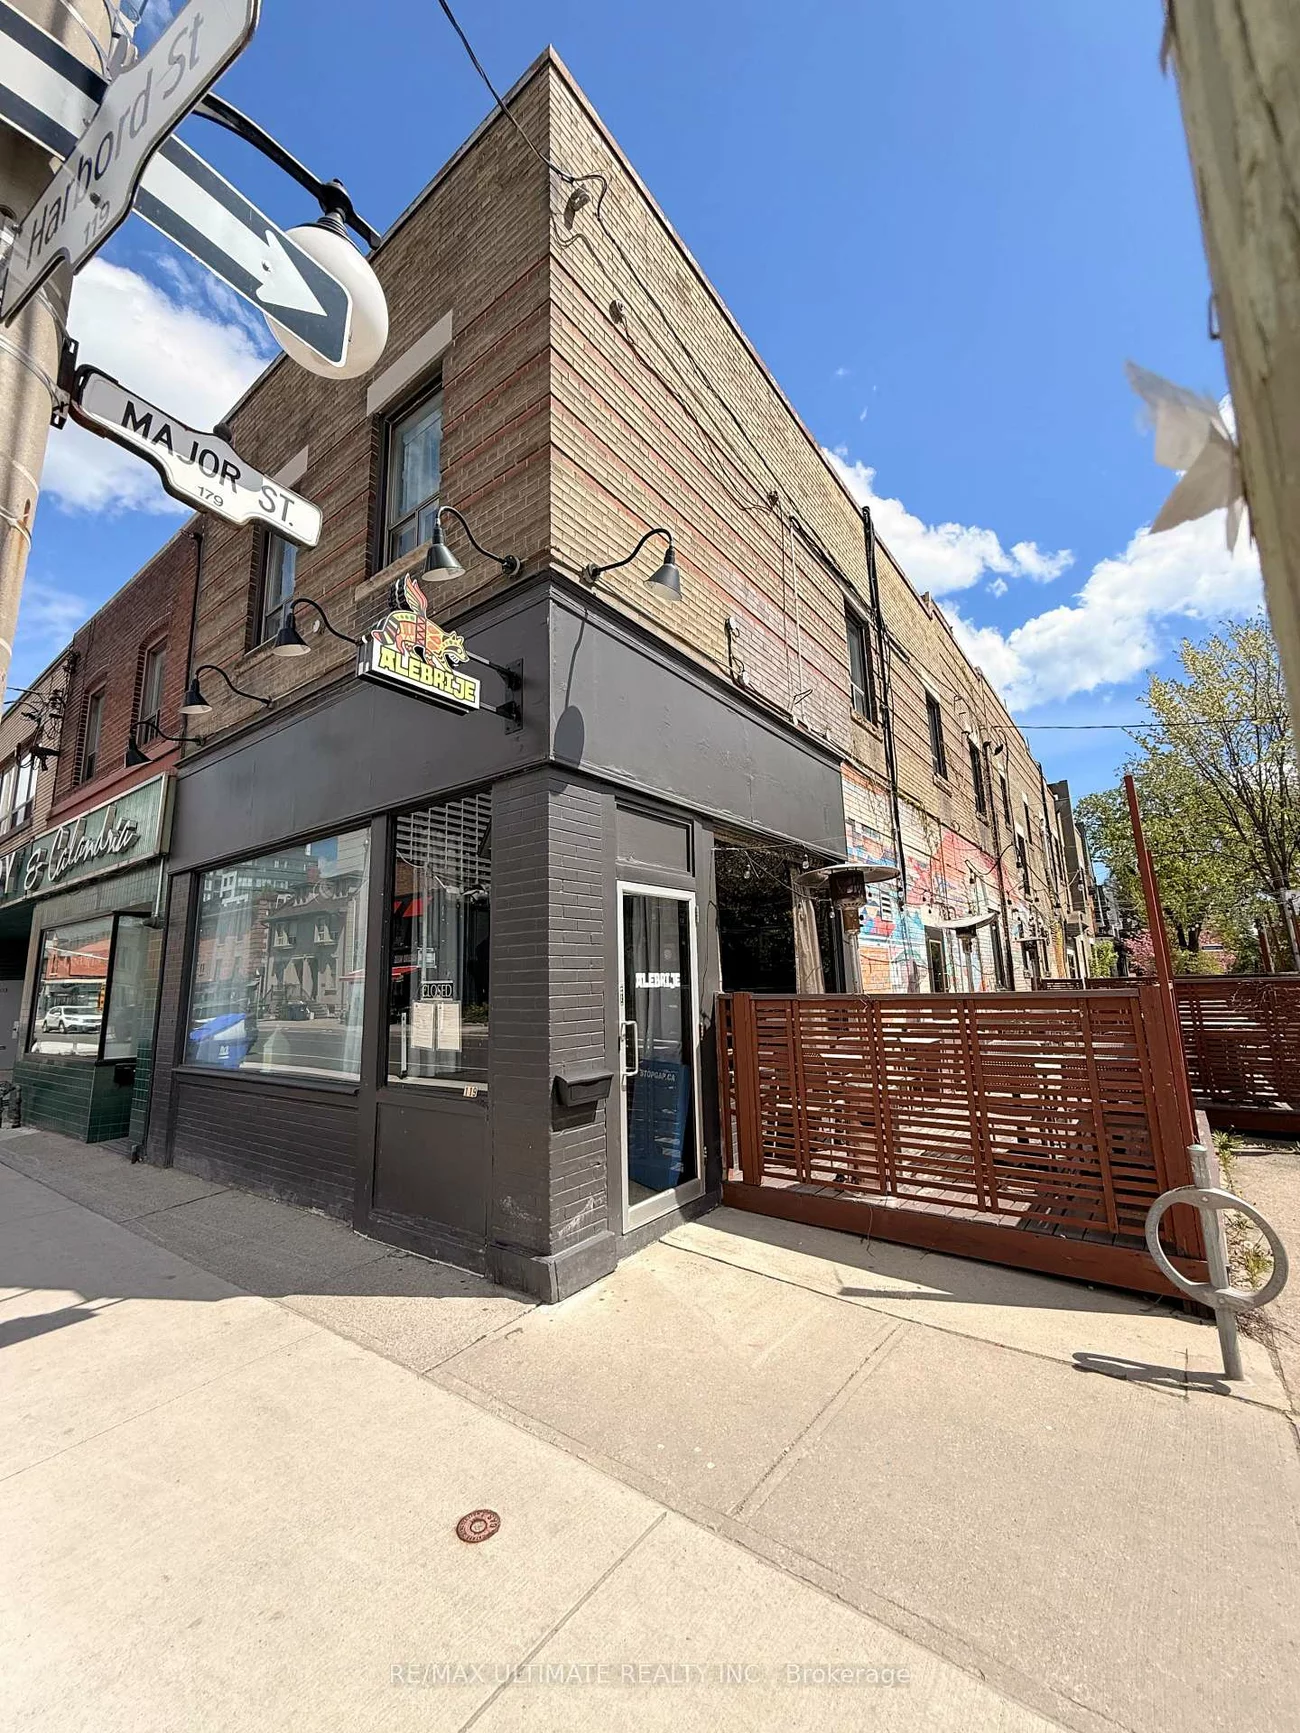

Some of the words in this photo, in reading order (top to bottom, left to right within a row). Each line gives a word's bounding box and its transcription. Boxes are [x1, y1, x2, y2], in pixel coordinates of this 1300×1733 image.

[26, 68, 154, 270] Harbord
[156, 12, 203, 100] St
[83, 200, 110, 245] 119
[120, 400, 242, 495] MAJOR
[258, 485, 295, 527] ST.
[197, 485, 224, 507] 179
[378, 645, 476, 702] ALEBRIJE
[422, 984, 452, 998] CLOSED
[635, 972, 681, 989] ALEBRIJE
